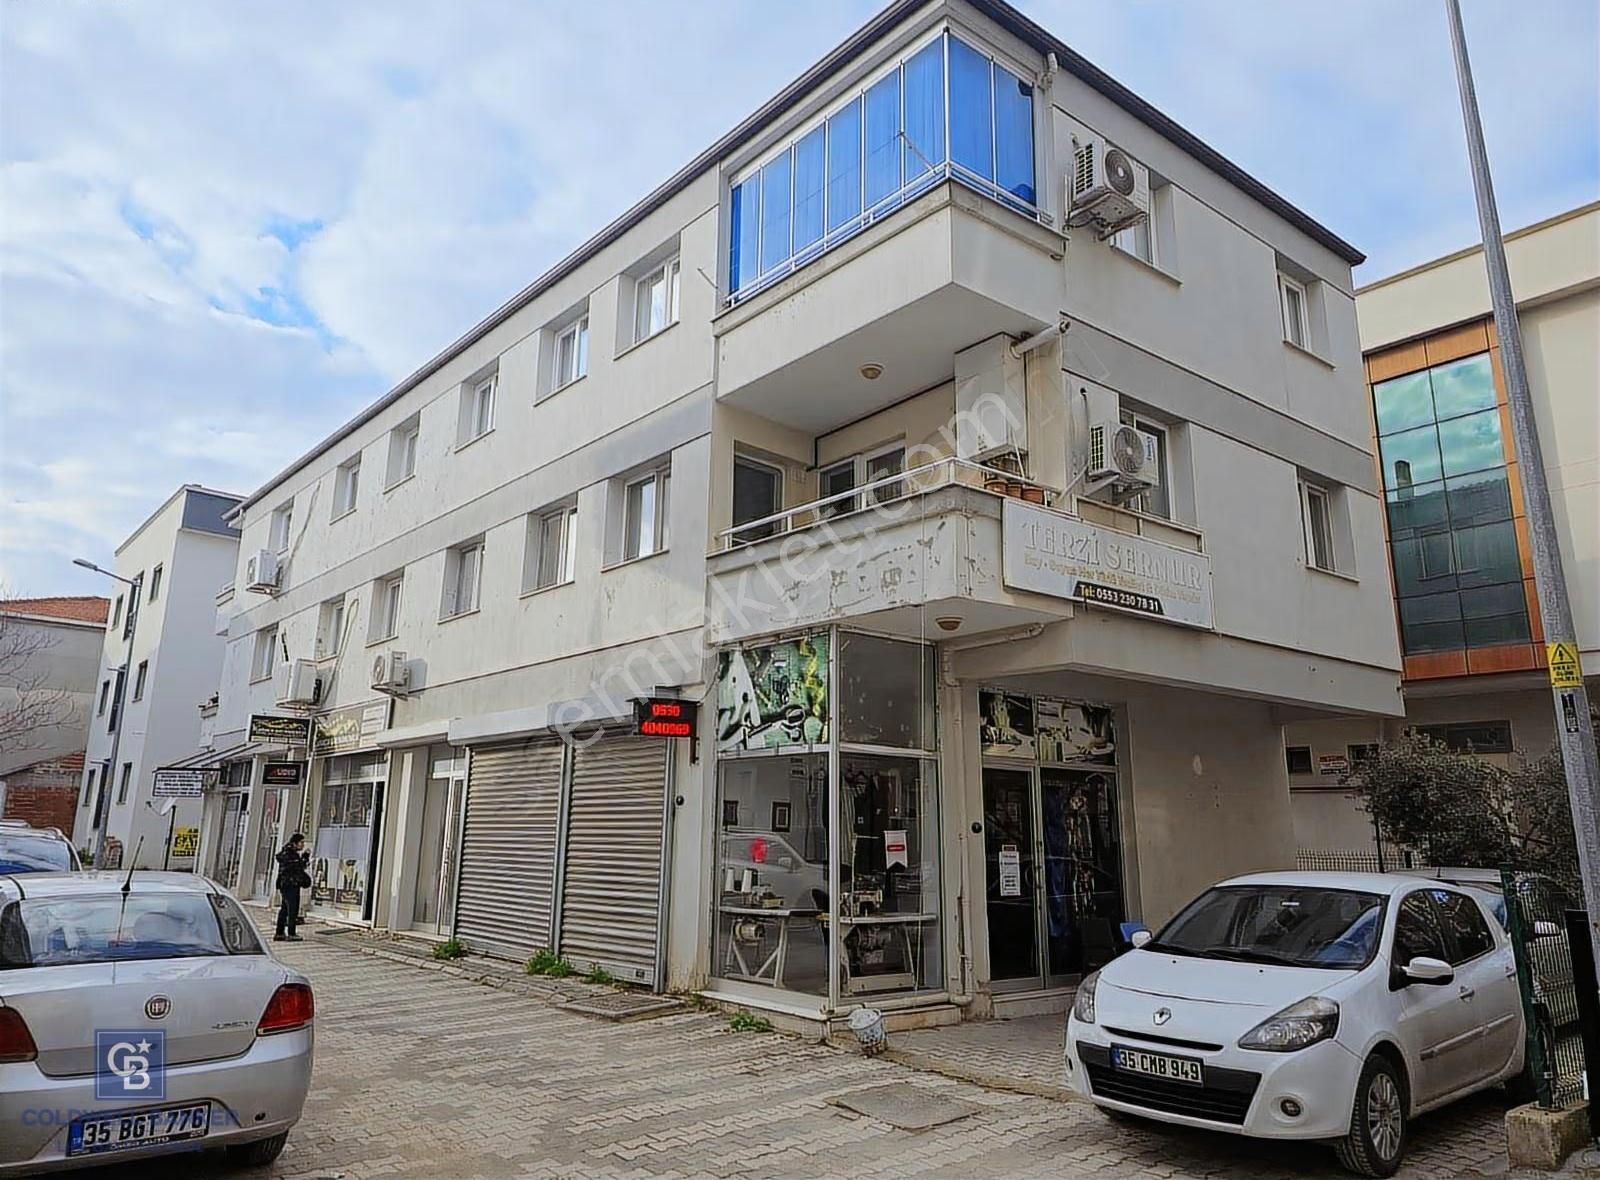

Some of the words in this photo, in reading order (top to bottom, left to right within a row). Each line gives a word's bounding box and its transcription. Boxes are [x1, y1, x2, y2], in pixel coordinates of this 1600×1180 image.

[1096, 588, 1118, 602] 0553
[1119, 1051, 1137, 1069] 35
[1170, 1060, 1200, 1081] 949
[84, 1121, 112, 1146] 35
[119, 1114, 159, 1142] BGT
[165, 1107, 204, 1134] 776
